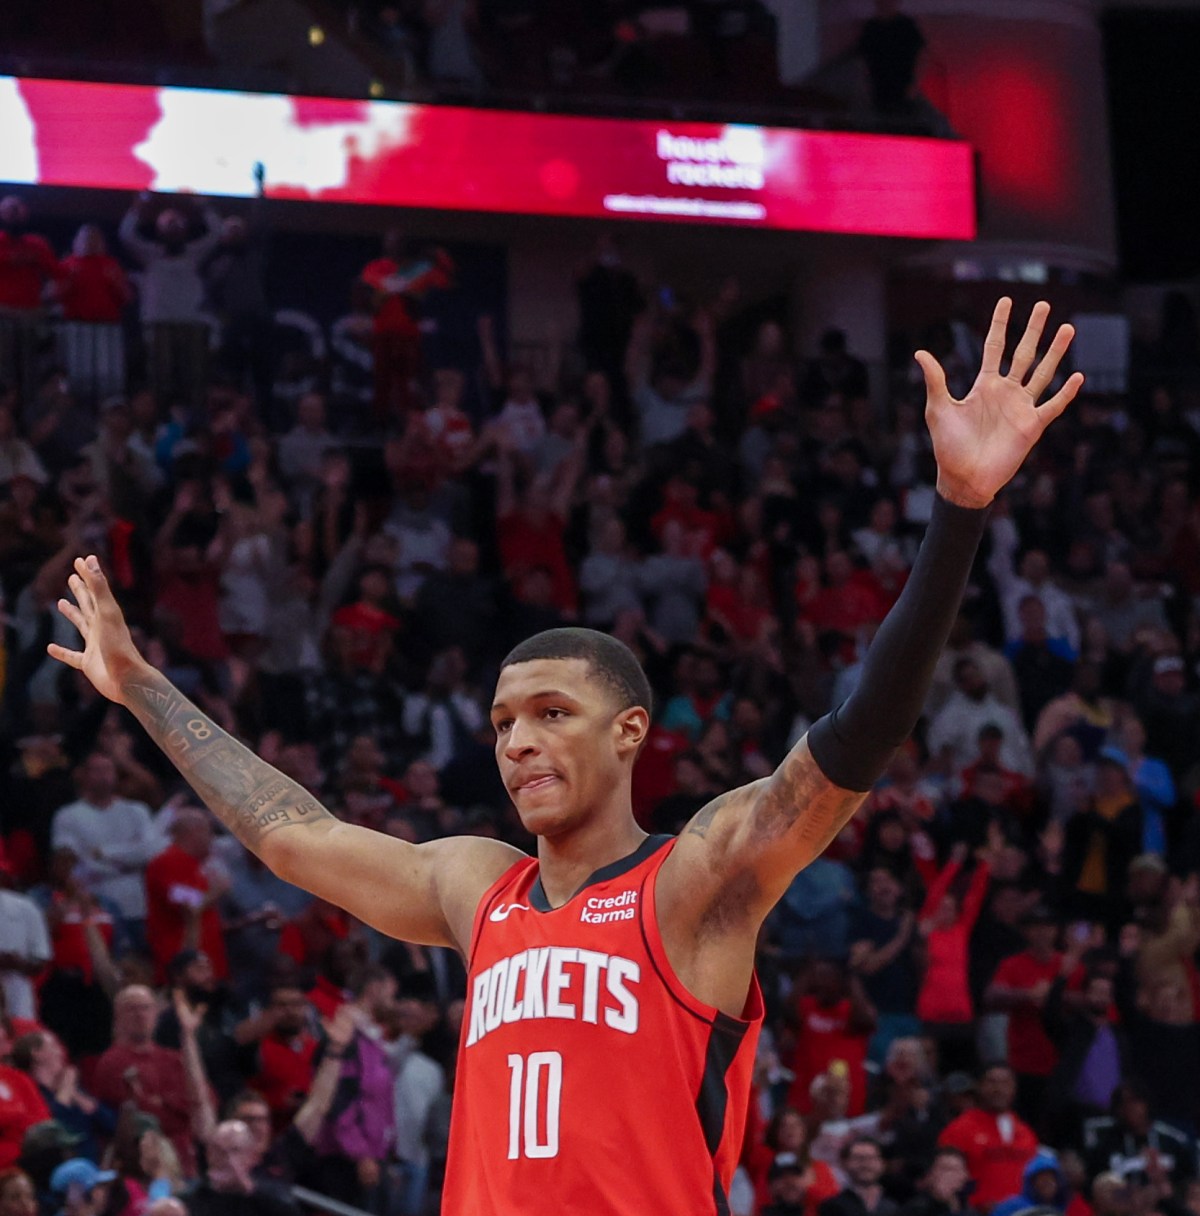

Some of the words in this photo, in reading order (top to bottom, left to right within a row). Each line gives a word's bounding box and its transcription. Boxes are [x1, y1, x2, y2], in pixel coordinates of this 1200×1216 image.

[580, 907, 635, 924] karma
[465, 945, 641, 1048] ROCKETS
[507, 1051, 563, 1160] 10
